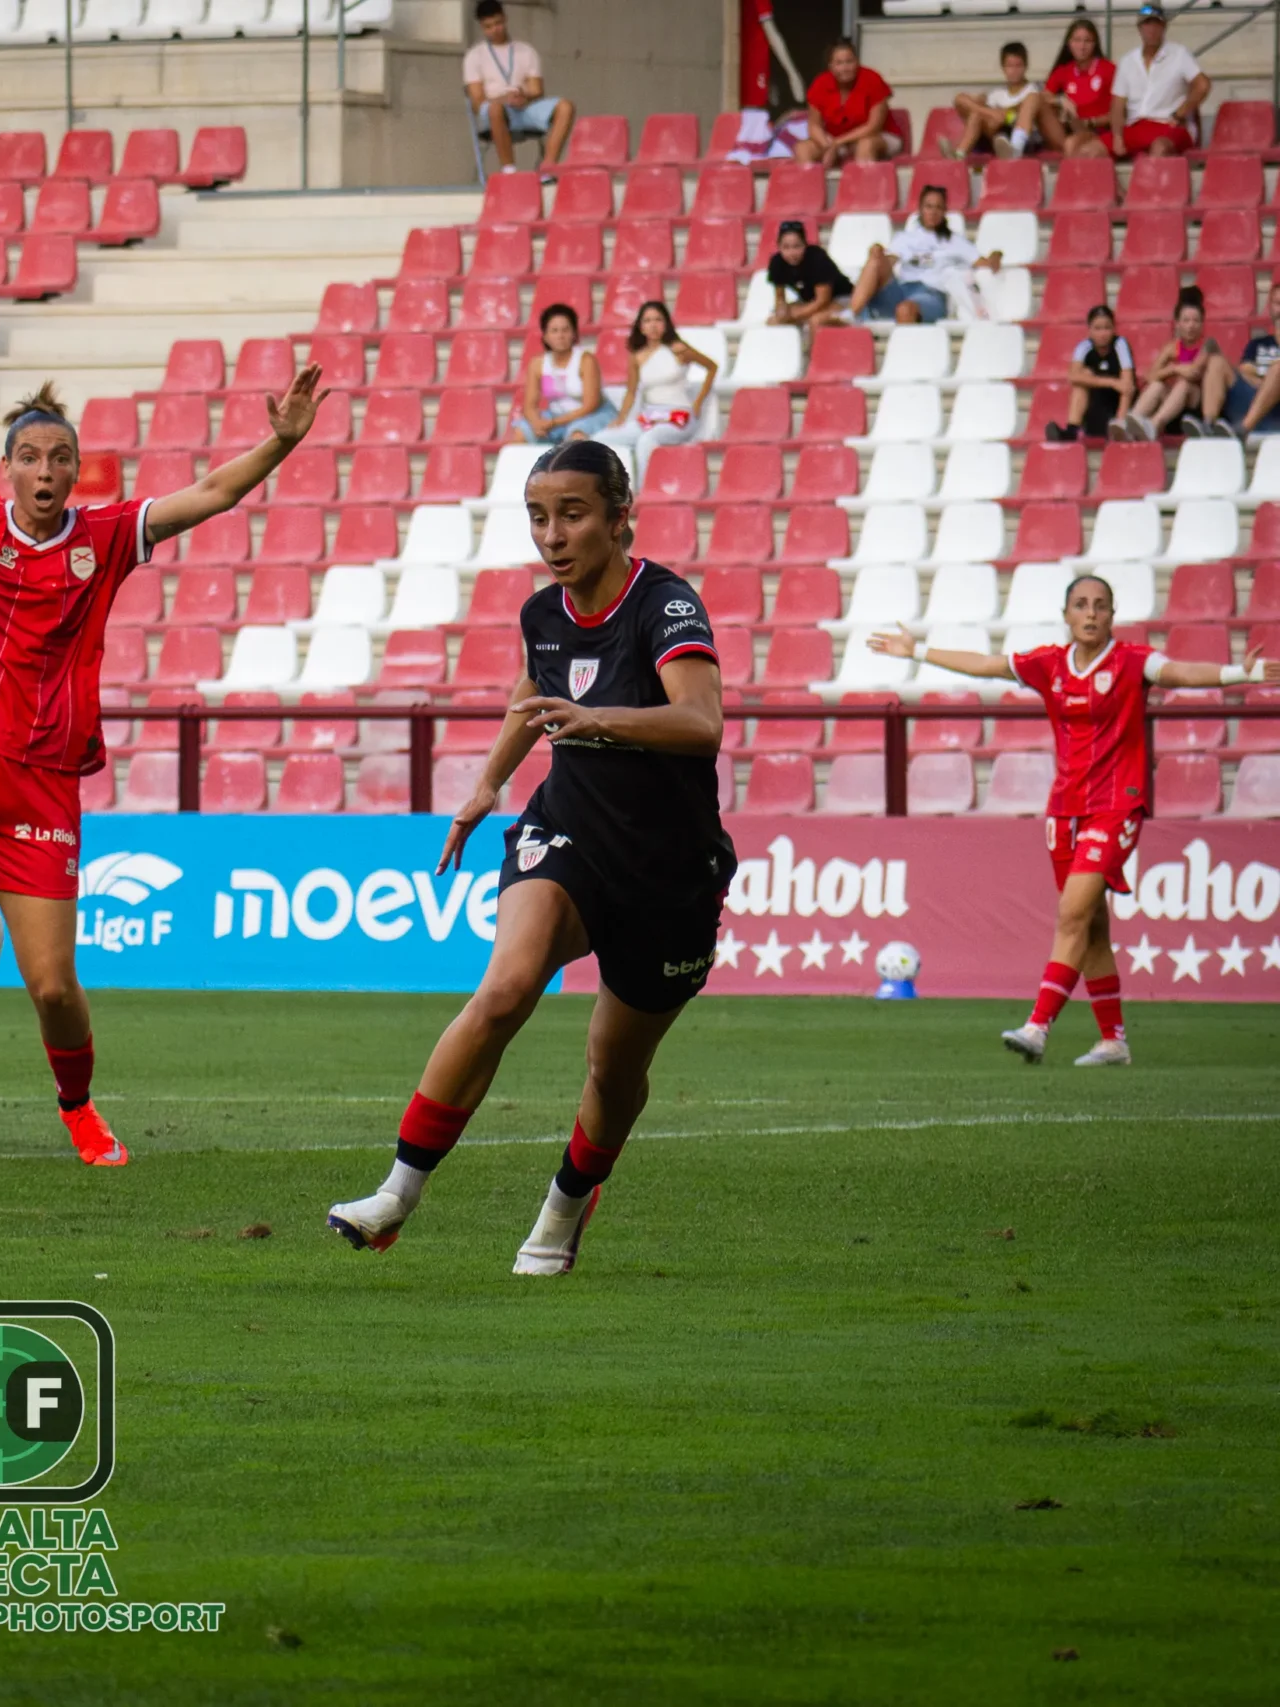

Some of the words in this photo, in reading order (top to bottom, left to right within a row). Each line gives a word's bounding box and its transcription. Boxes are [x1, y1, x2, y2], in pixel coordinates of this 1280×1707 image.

[35, 826, 51, 842] La
[723, 835, 909, 918] ahou
[1105, 837, 1280, 922] aho
[76, 908, 146, 953] Liga
[151, 910, 174, 946] F
